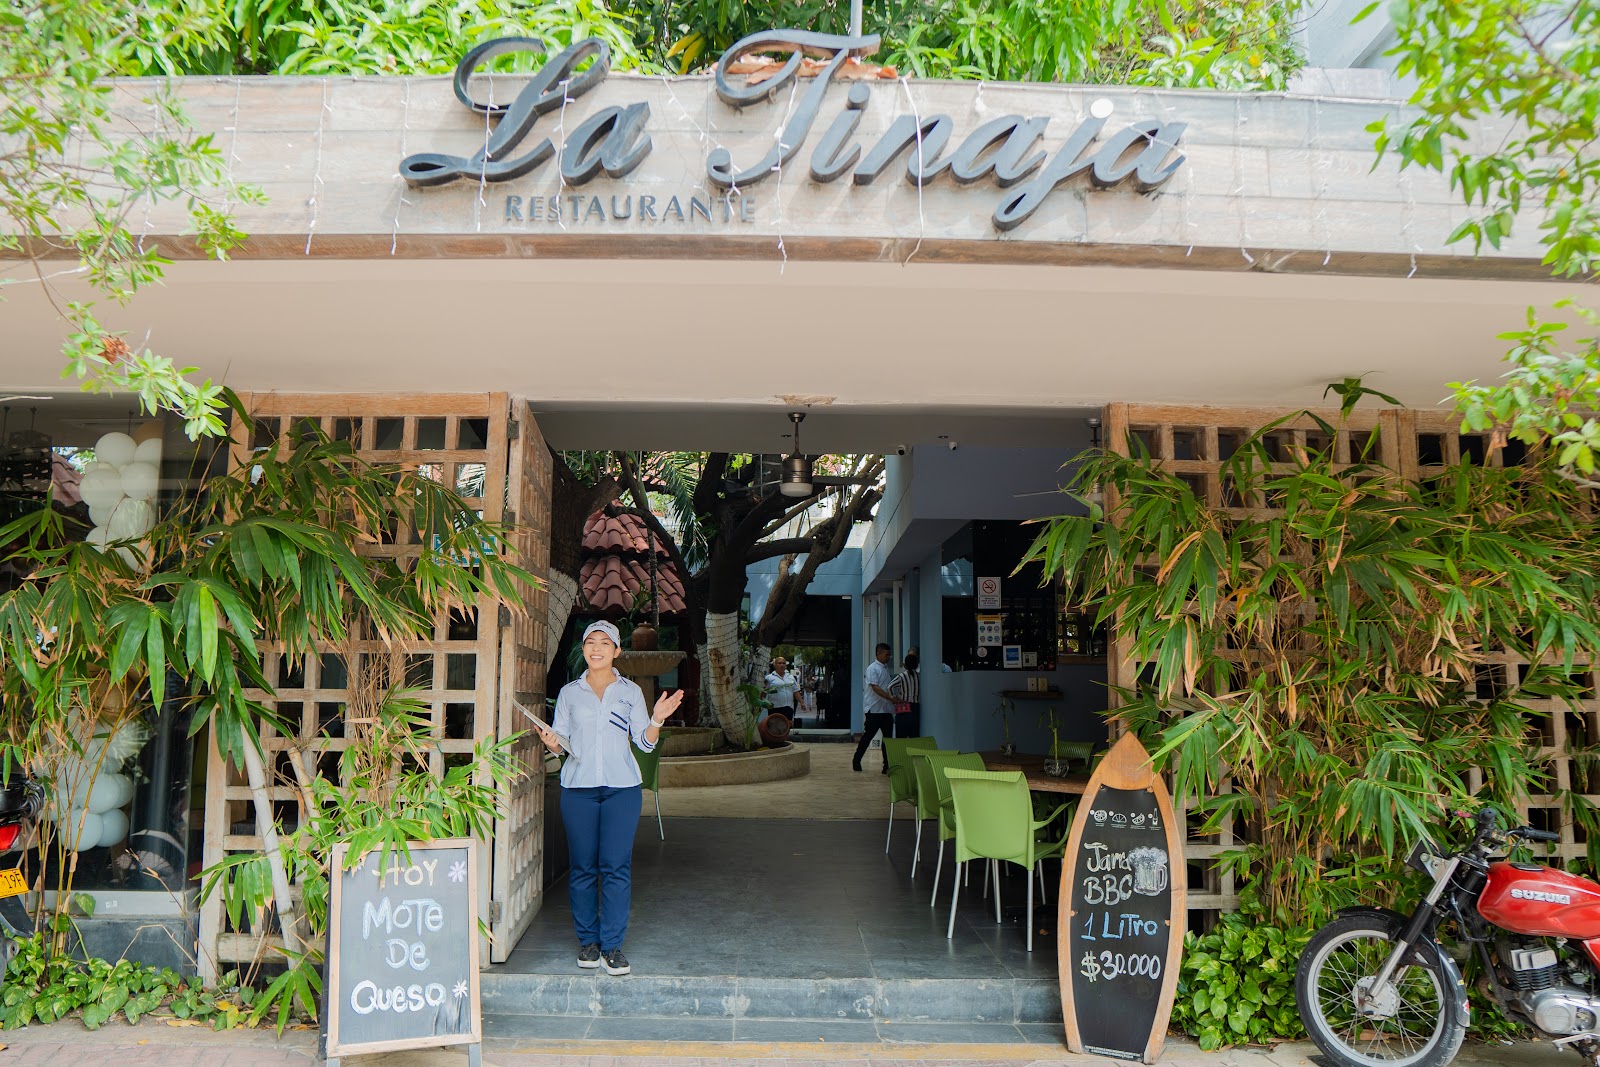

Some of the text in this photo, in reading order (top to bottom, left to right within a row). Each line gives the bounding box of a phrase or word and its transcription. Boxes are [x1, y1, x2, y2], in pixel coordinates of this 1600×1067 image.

[400, 29, 1188, 231] La Tinaja
[504, 195, 756, 223] RESTAURANTE
[1083, 873, 1133, 905] BBC
[1511, 888, 1570, 905] SUZUKI
[1081, 912, 1096, 941] 1
[1080, 950, 1161, 982] $30.000
